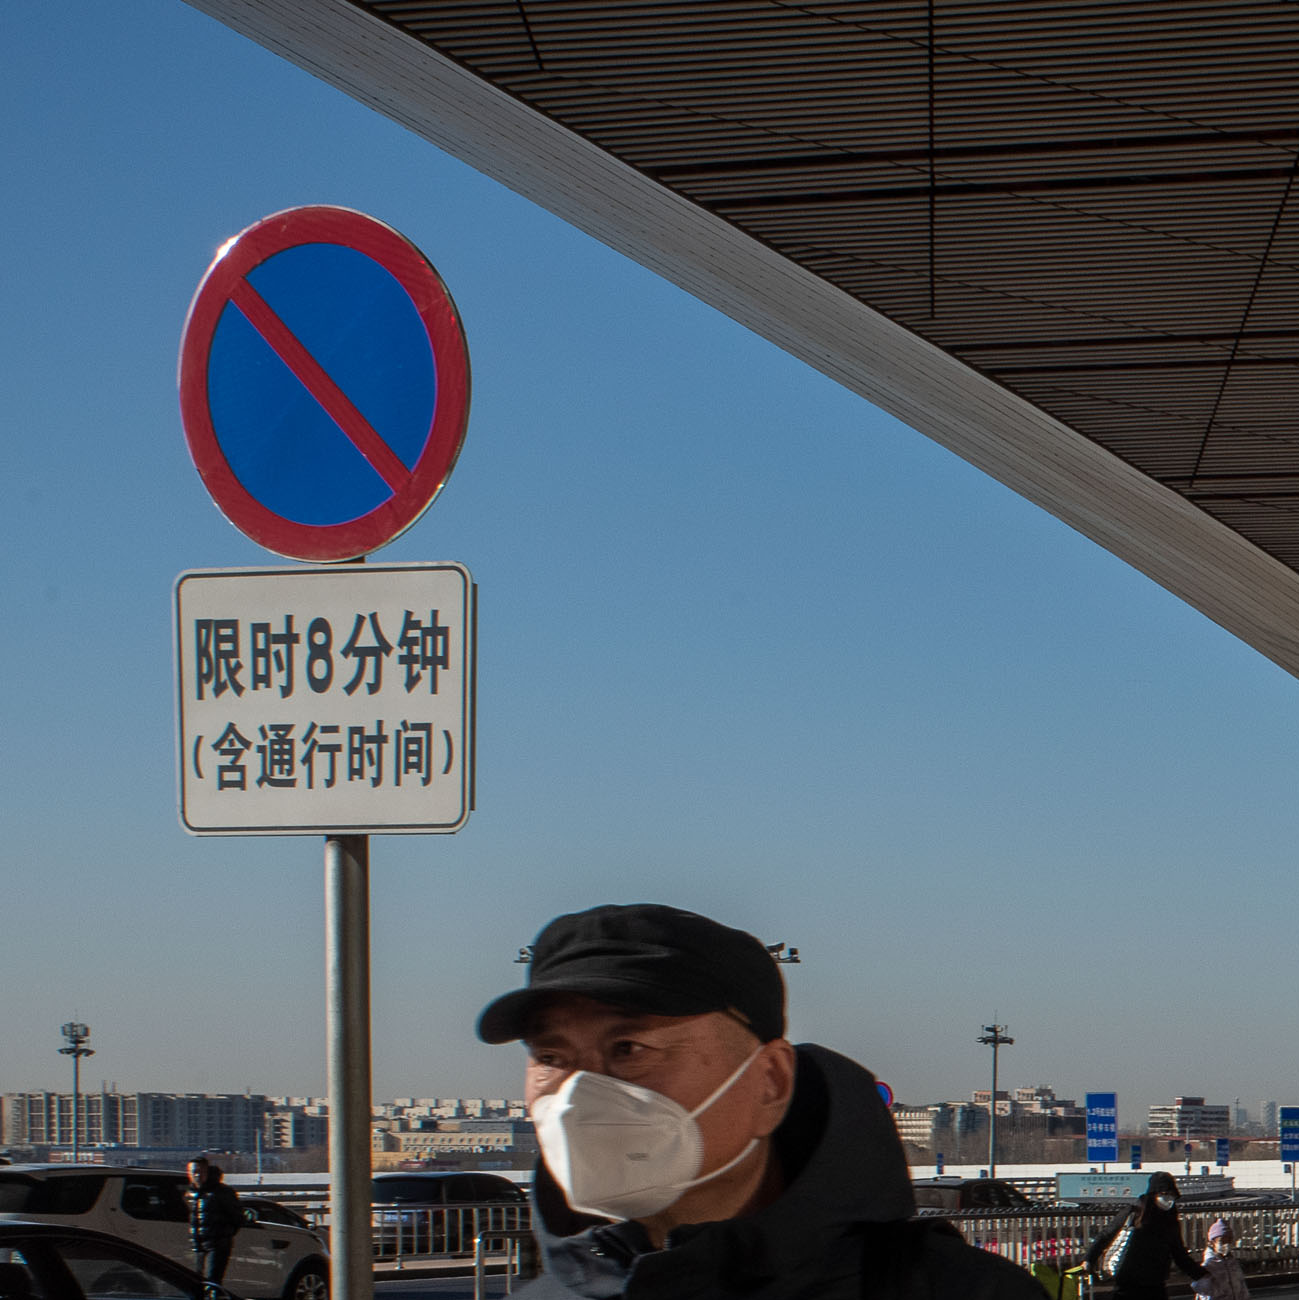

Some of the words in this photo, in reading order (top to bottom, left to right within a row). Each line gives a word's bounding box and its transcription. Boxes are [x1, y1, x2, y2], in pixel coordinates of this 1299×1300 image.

[194, 609, 451, 700] 限时8分钟
[192, 719, 454, 791] (含通行时间)
